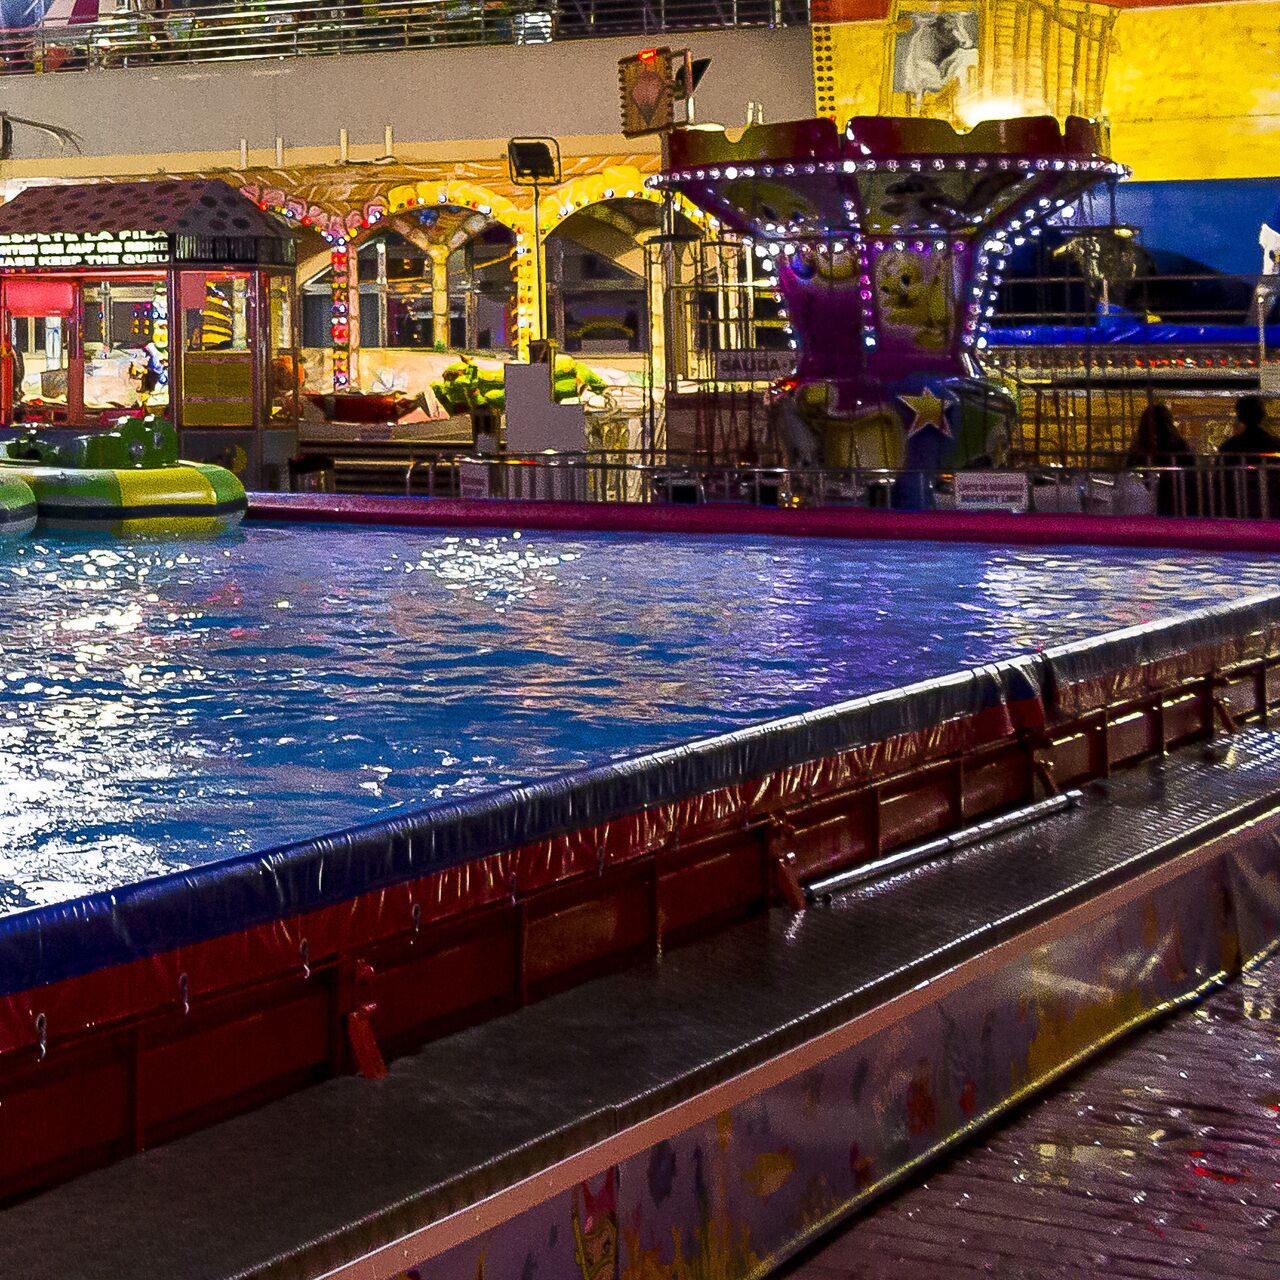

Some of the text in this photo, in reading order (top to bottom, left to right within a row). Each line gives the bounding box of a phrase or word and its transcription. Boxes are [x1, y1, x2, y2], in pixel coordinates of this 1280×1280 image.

[84, 231, 114, 242] LA
[38, 255, 83, 267] KEEP
[84, 254, 120, 265] THE
